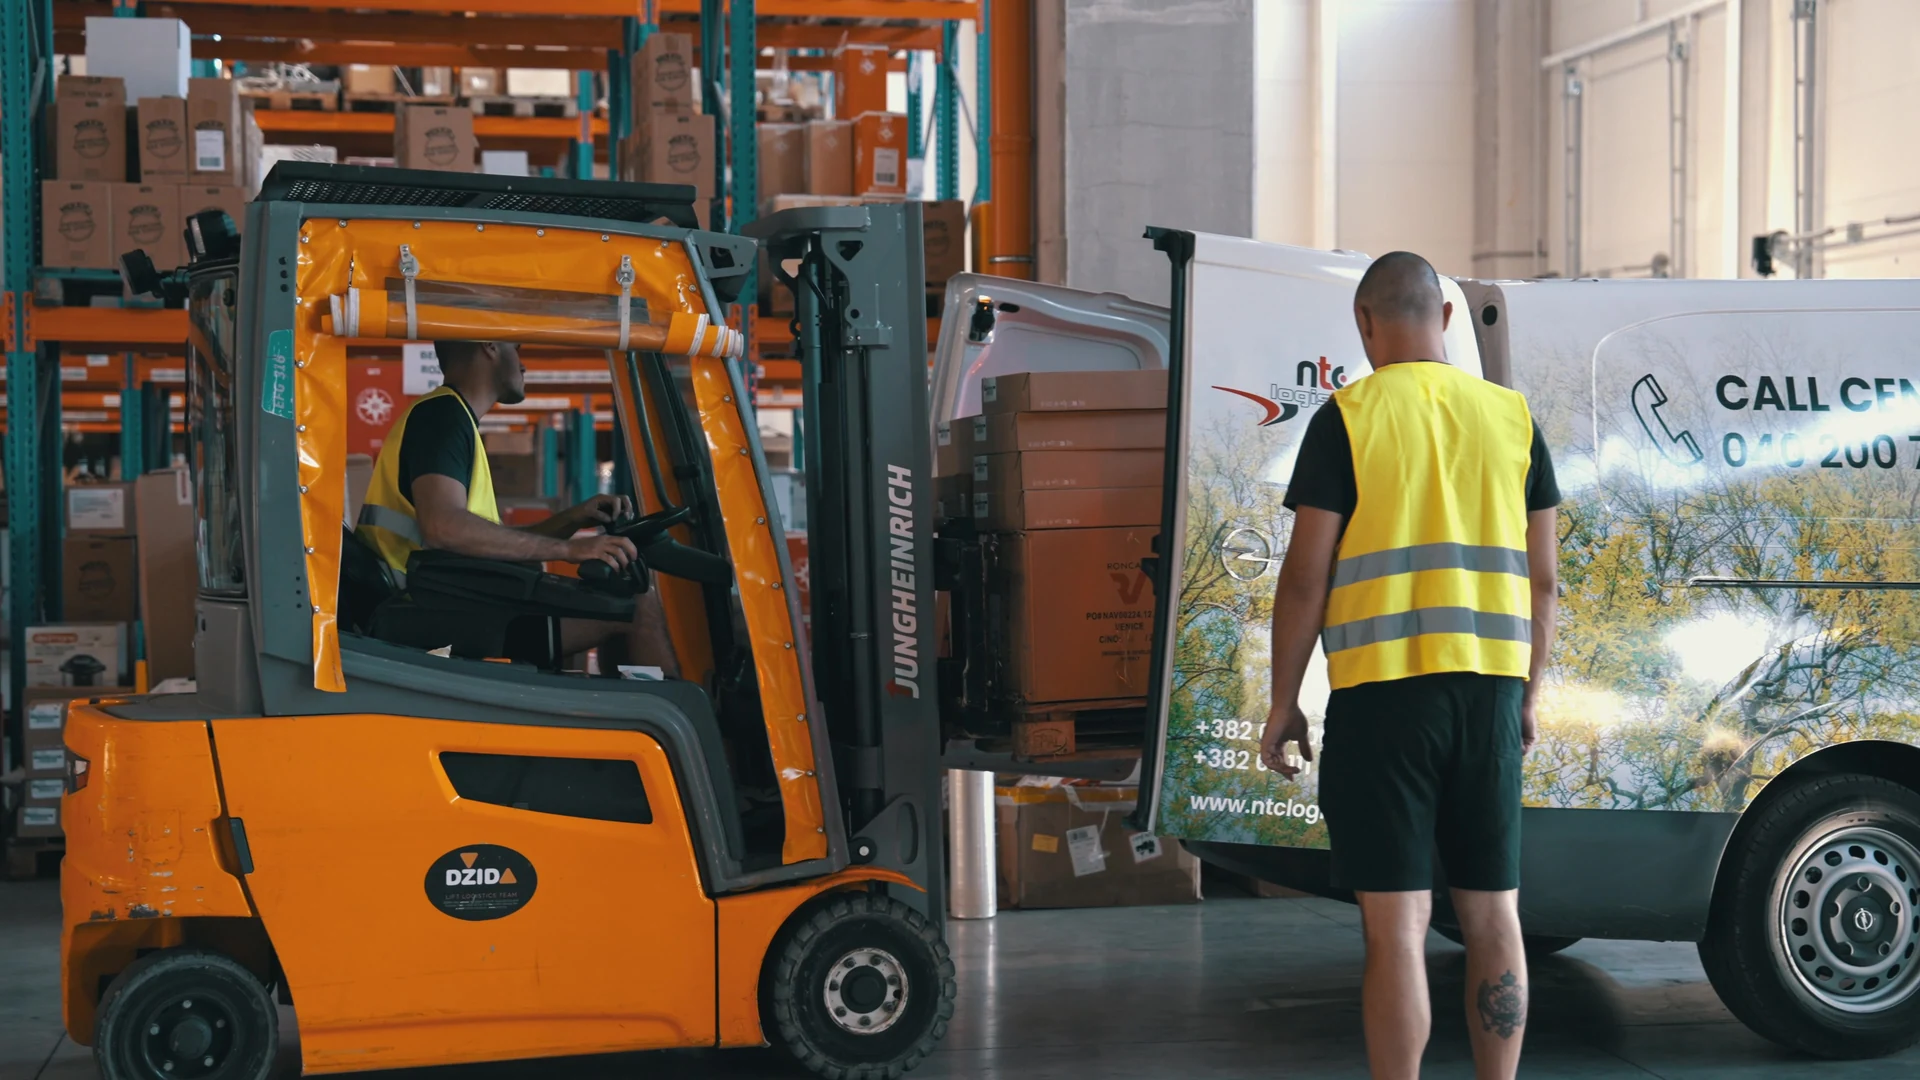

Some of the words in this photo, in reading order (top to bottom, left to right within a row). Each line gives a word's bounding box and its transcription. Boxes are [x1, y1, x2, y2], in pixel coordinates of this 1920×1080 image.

[1297, 356, 1345, 391] ntc
[1716, 375, 1830, 411] CALL
[1818, 433, 1897, 470] 200
[887, 464, 920, 699] JUNGHEINRICH
[1196, 718, 1253, 741] +382
[1193, 748, 1250, 771] +382
